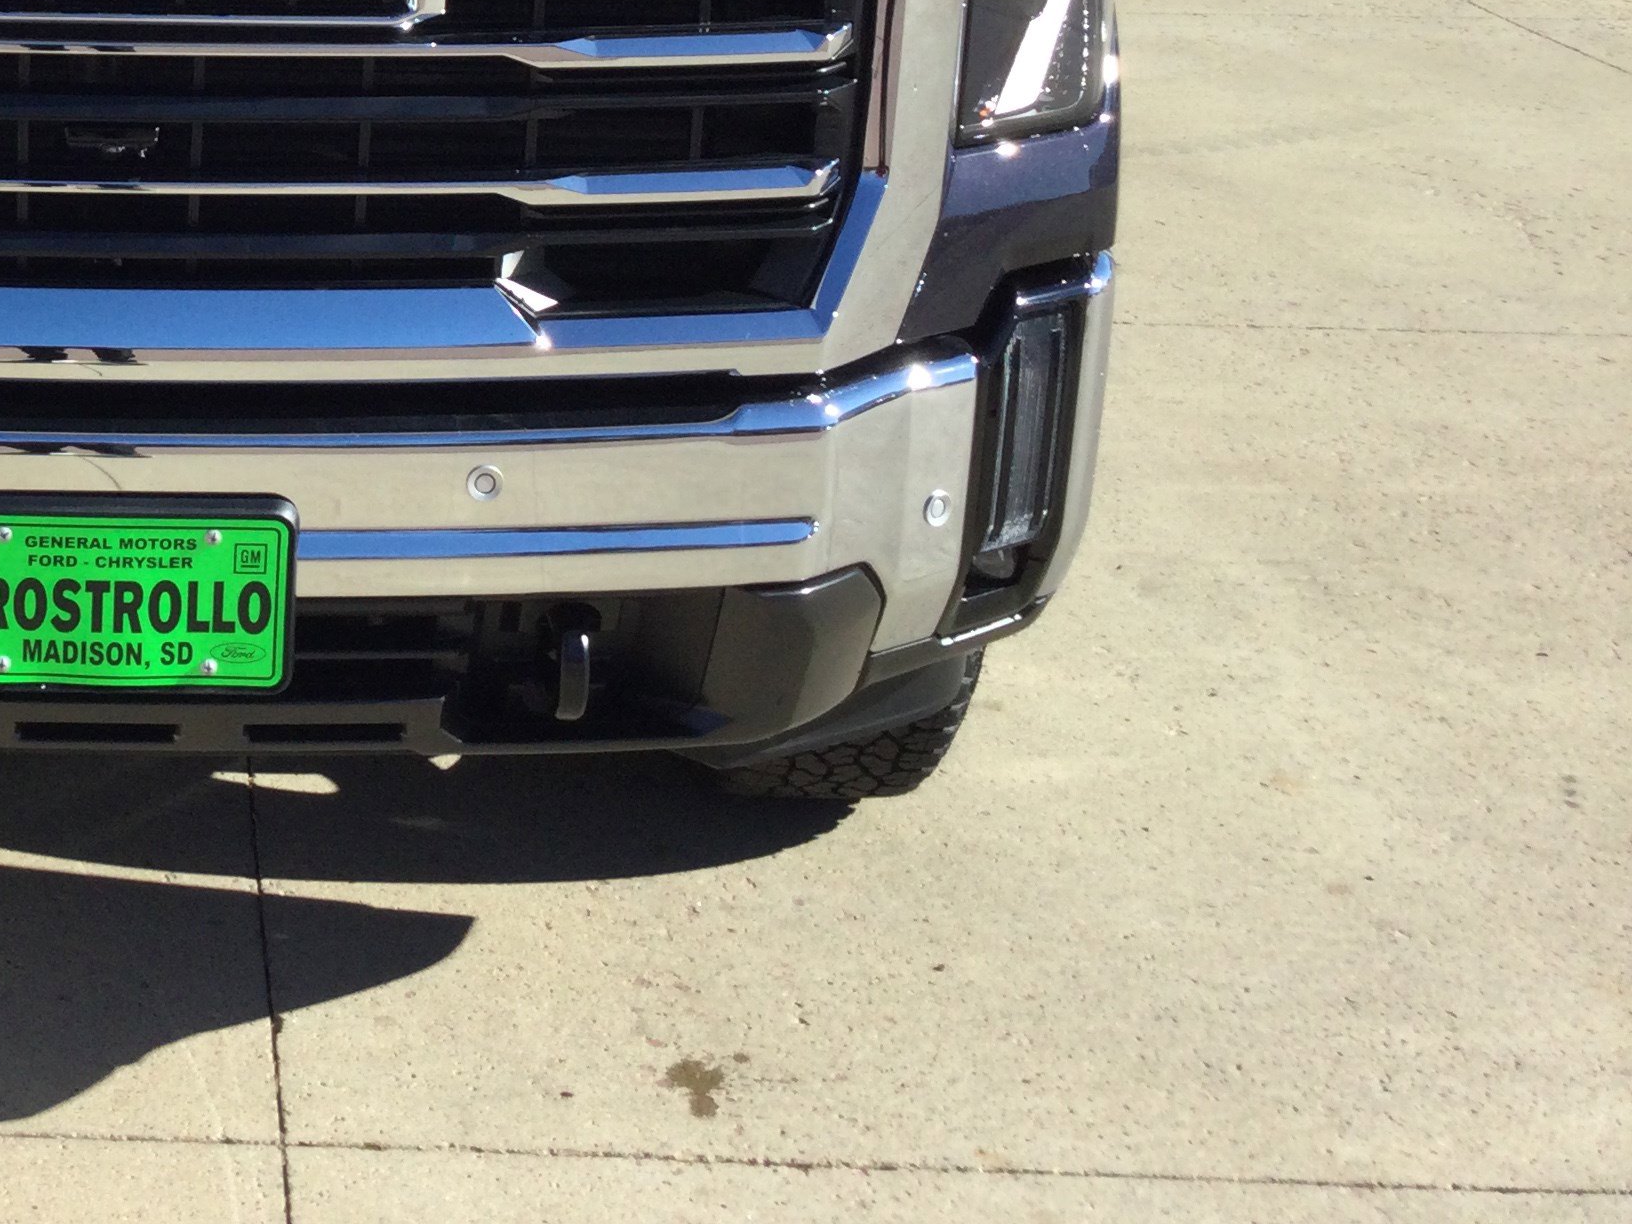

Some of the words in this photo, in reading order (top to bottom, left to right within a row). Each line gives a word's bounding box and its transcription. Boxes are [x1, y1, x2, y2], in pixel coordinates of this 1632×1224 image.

[24, 535, 113, 550] GENERAL
[118, 537, 198, 551] MOTORS
[27, 554, 78, 567] FORD
[95, 556, 194, 569] CHRYSLER
[240, 549, 261, 564] GM
[22, 639, 151, 670] MADISON,
[160, 641, 193, 665] SD
[220, 645, 256, 659] Ford
